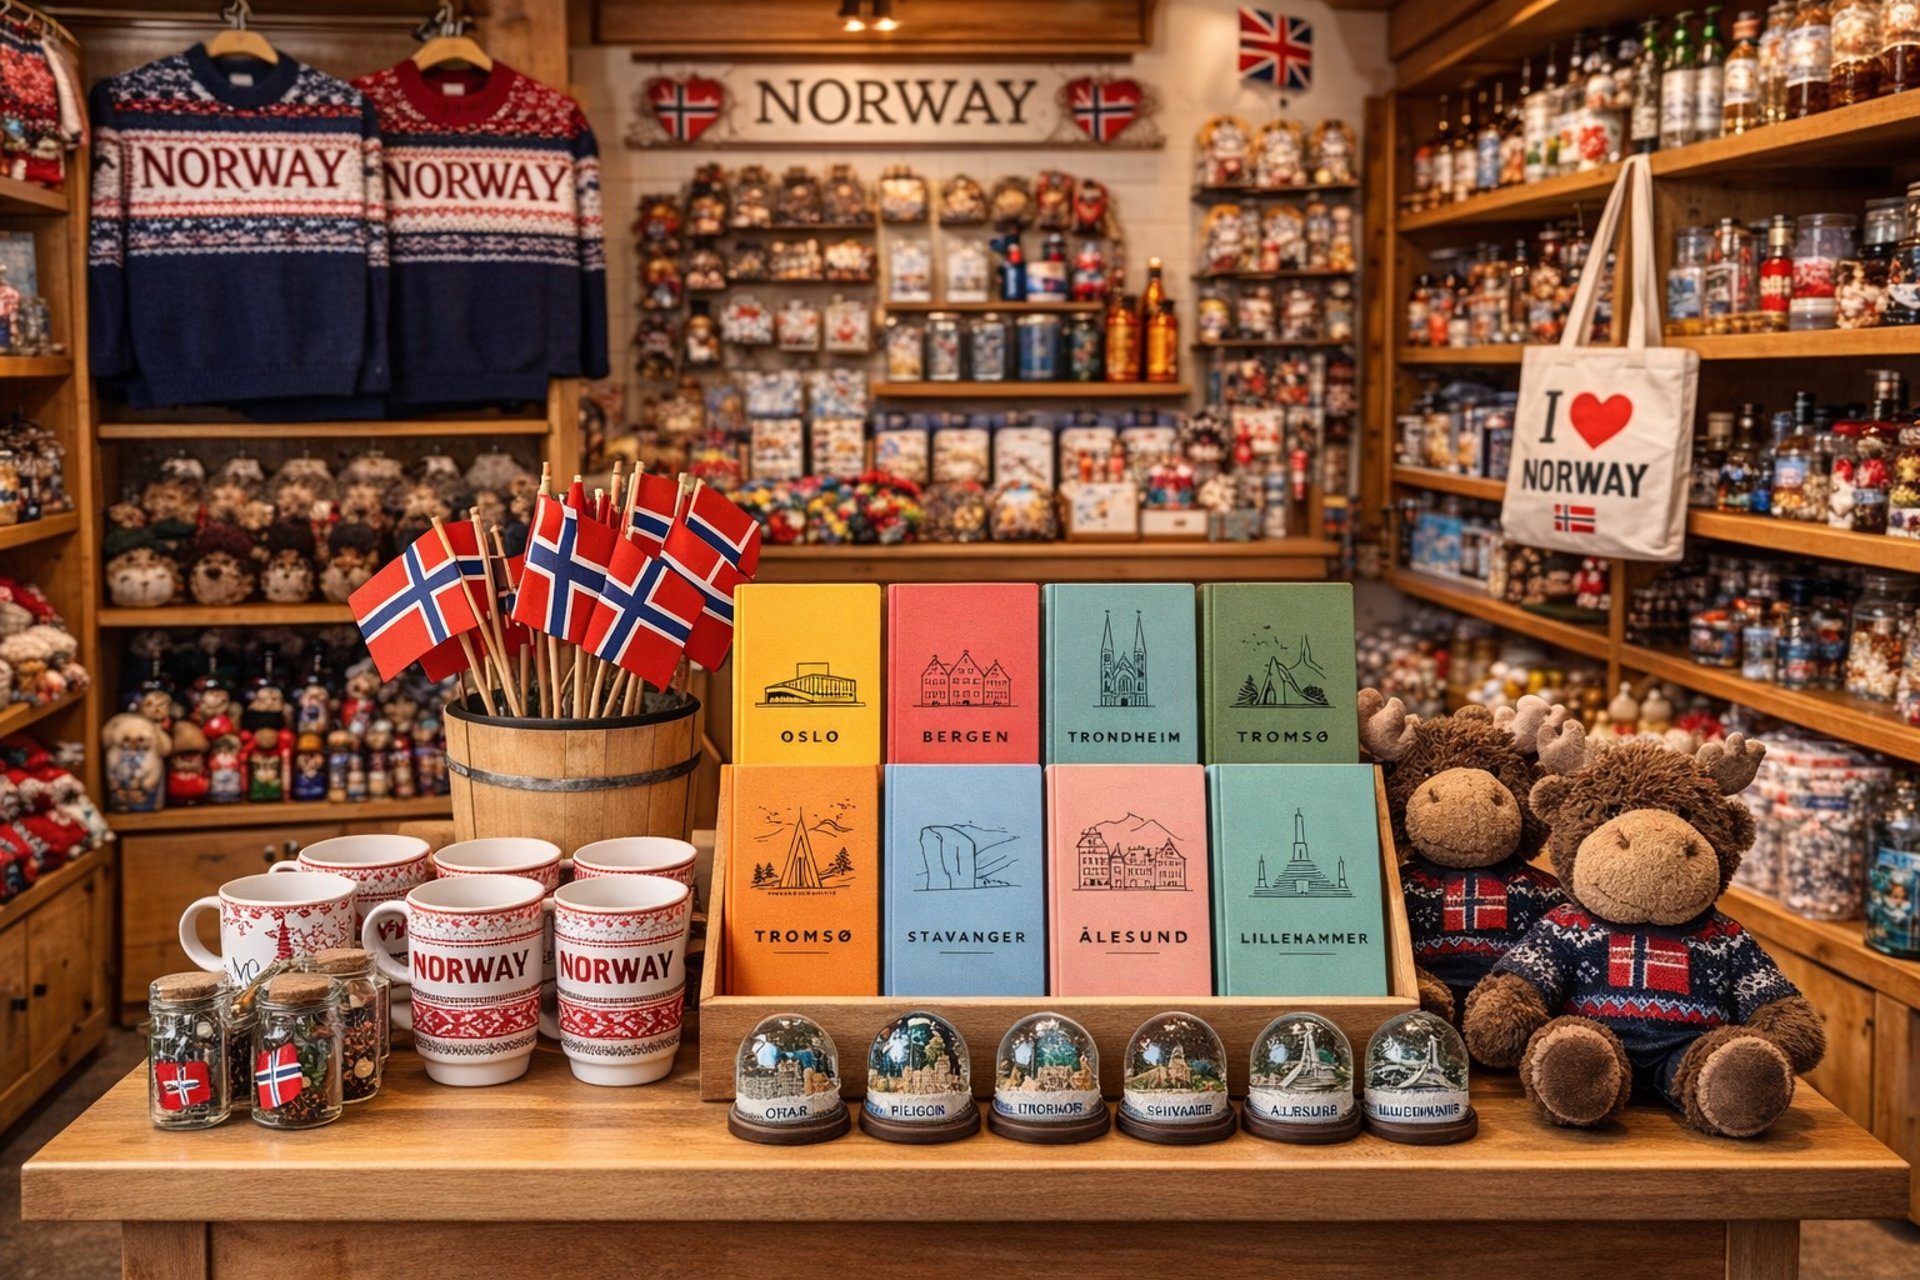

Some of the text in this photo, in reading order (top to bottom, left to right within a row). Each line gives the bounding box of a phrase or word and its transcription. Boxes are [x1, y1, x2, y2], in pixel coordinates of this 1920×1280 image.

[754, 78, 1038, 125] NORWAY
[139, 146, 347, 189] NORWAY
[383, 161, 567, 201] NORWAY
[1539, 390, 1563, 443] I
[1522, 459, 1649, 498] NORWAY
[780, 730, 839, 743] OSLO
[922, 730, 1009, 743] BERGEN
[1067, 731, 1181, 743] TRONDHEIM
[754, 930, 852, 944] TROMSØ
[907, 930, 1026, 944] STAVANGER
[1079, 926, 1189, 944] ÅLESUND
[1240, 932, 1369, 945] LILLEHAMMER
[413, 950, 529, 984] NORWAY
[560, 950, 674, 984] NORWAY
